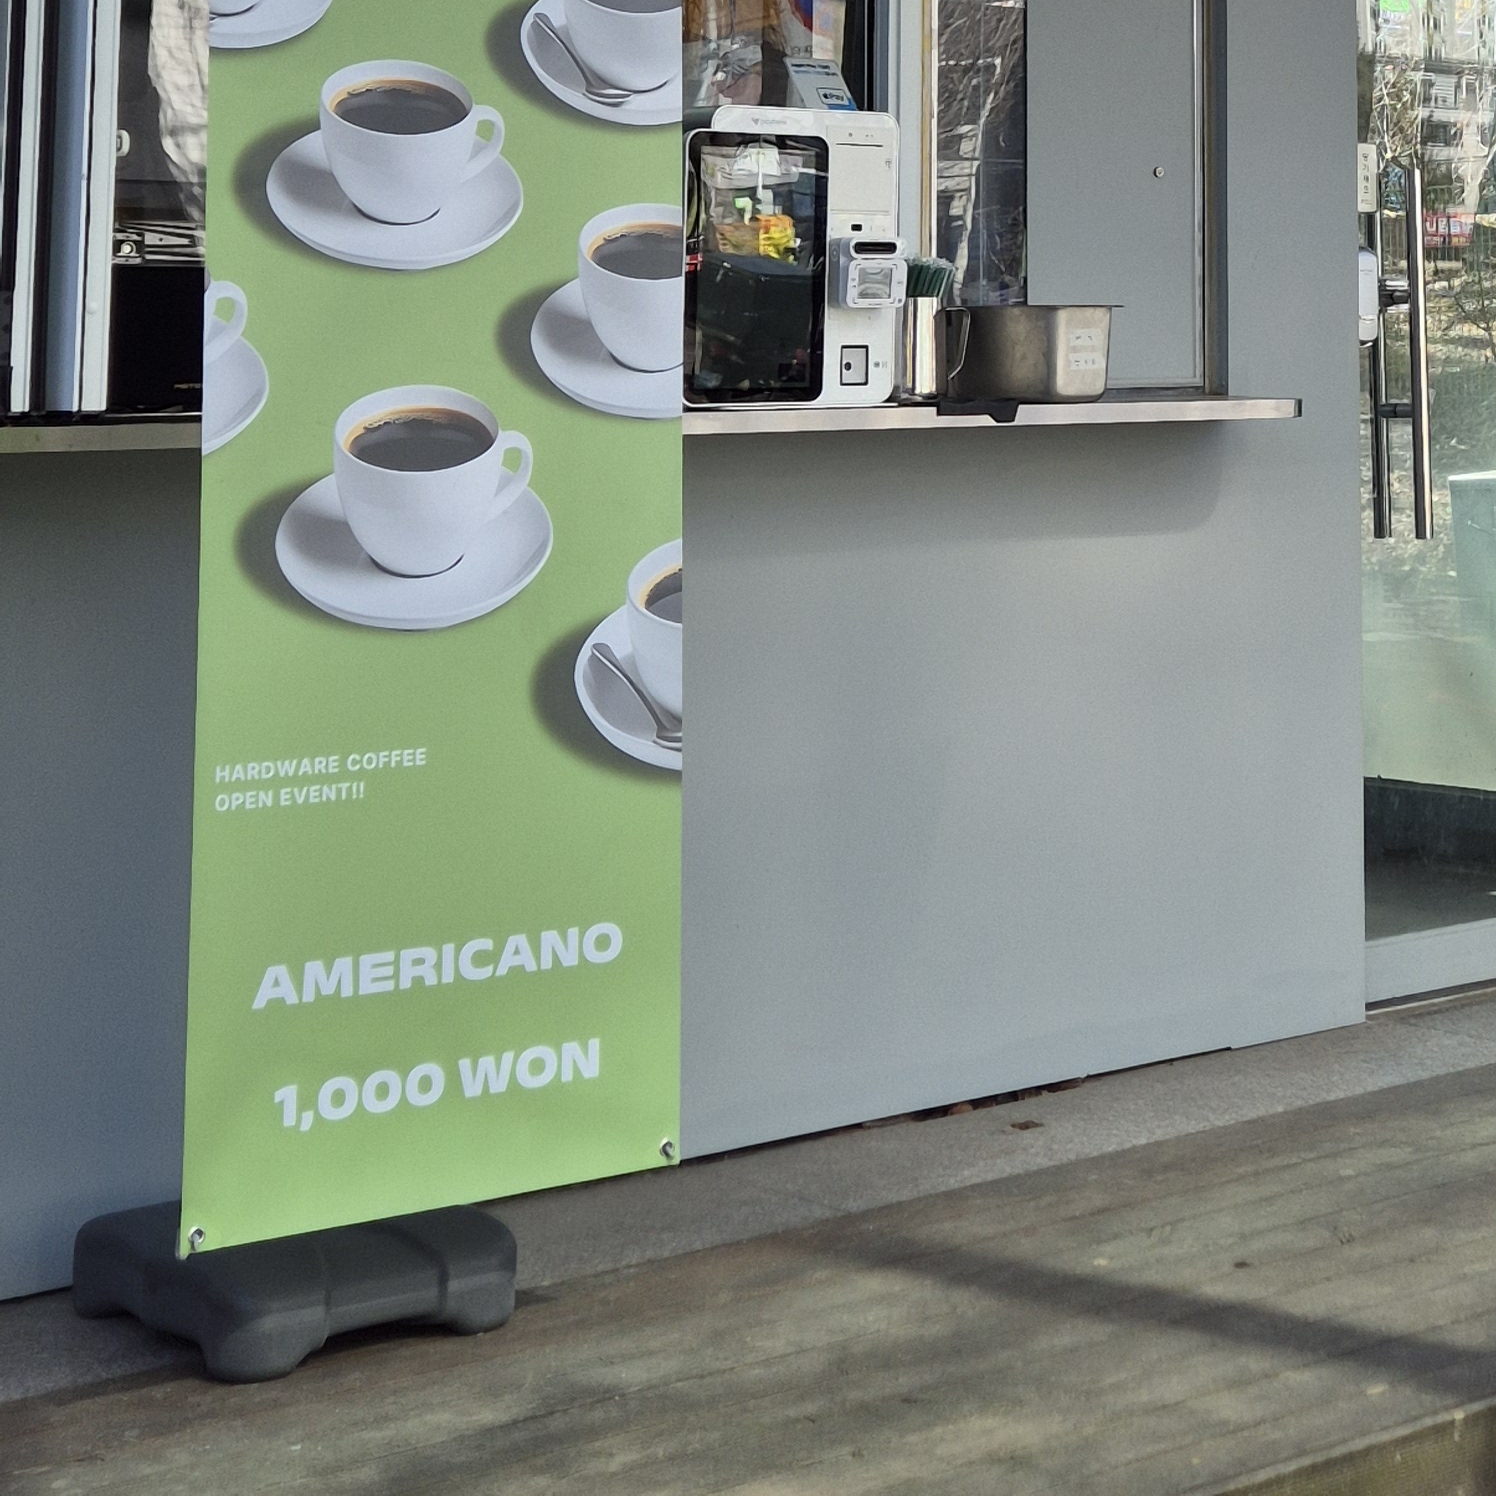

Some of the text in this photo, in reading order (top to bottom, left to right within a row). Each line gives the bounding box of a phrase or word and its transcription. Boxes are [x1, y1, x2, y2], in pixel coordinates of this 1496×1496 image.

[215, 748, 427, 784] HARDWARE COFFEE
[215, 782, 366, 812] OPEN EVENT!!
[252, 922, 623, 1010] AMERICANO
[274, 1038, 600, 1132] 1,000 WON
